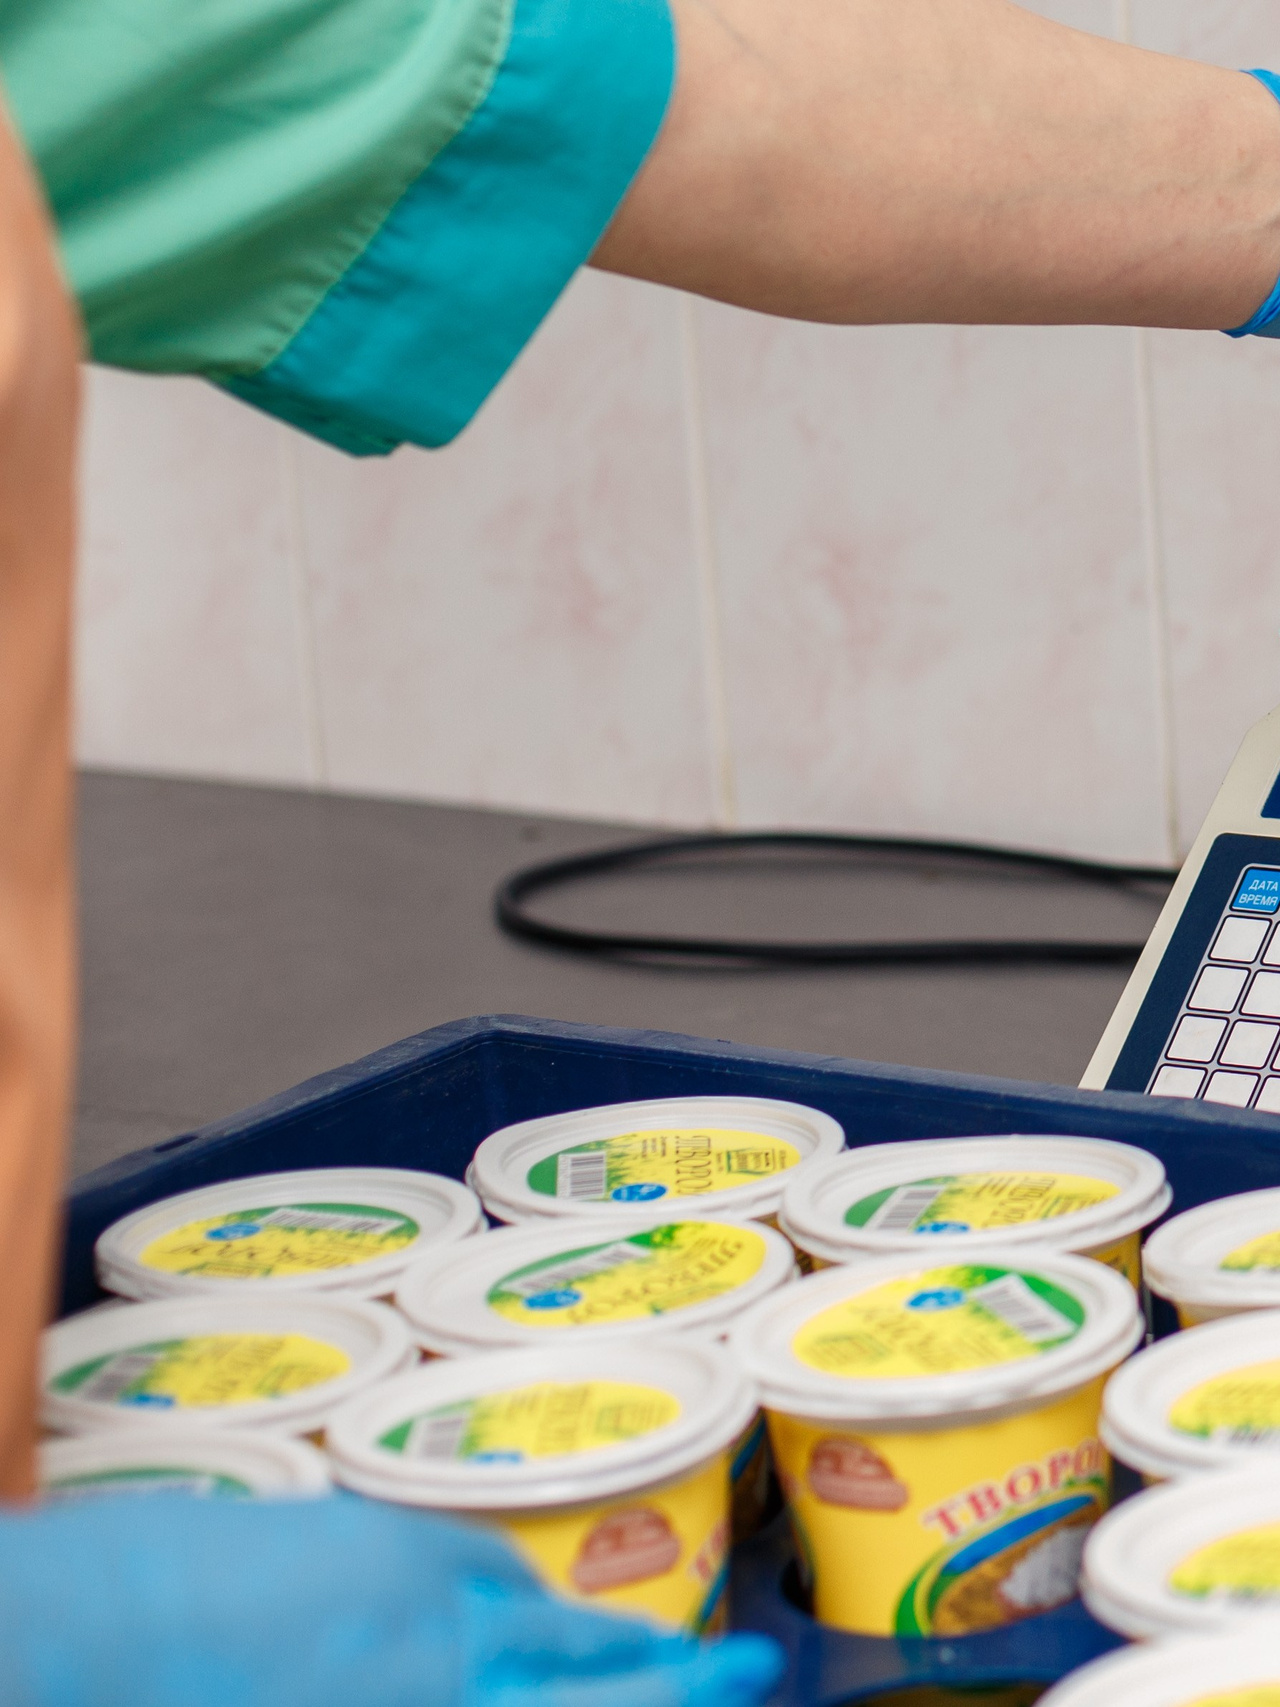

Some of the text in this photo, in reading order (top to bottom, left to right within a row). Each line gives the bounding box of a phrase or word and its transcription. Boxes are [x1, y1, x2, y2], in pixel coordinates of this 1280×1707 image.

[1248, 879, 1279, 892] ДАТА
[1238, 893, 1279, 907] ВРЕМЯ
[923, 1440, 1102, 1537] ТВОРО
